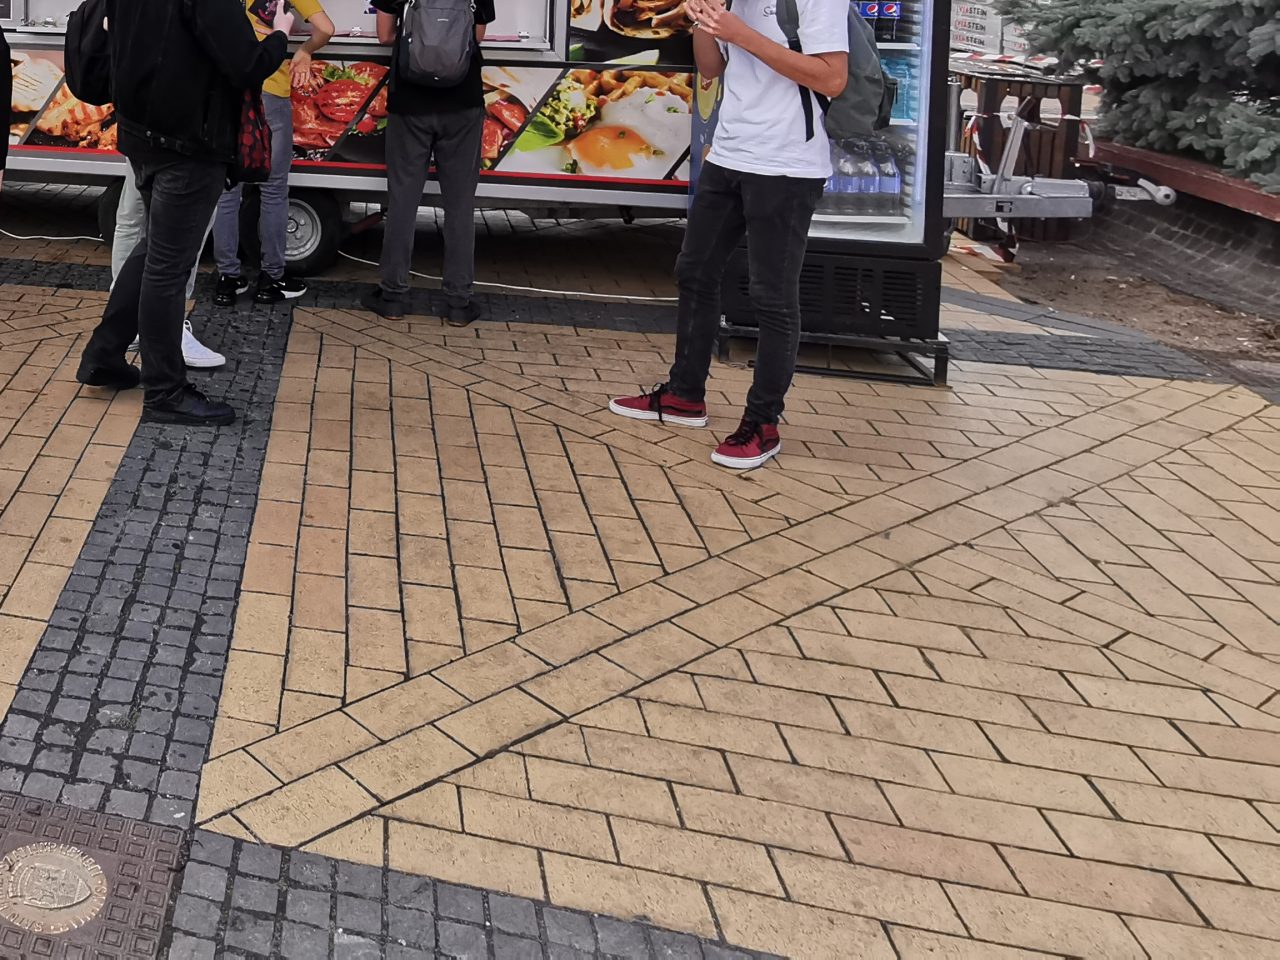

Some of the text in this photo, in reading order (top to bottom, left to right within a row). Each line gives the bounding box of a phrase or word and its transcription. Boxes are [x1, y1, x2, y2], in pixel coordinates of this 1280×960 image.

[960, 5, 987, 17] VIASTEIN
[957, 20, 986, 32] VIASTEIN
[954, 35, 985, 46] VIASTEIN
